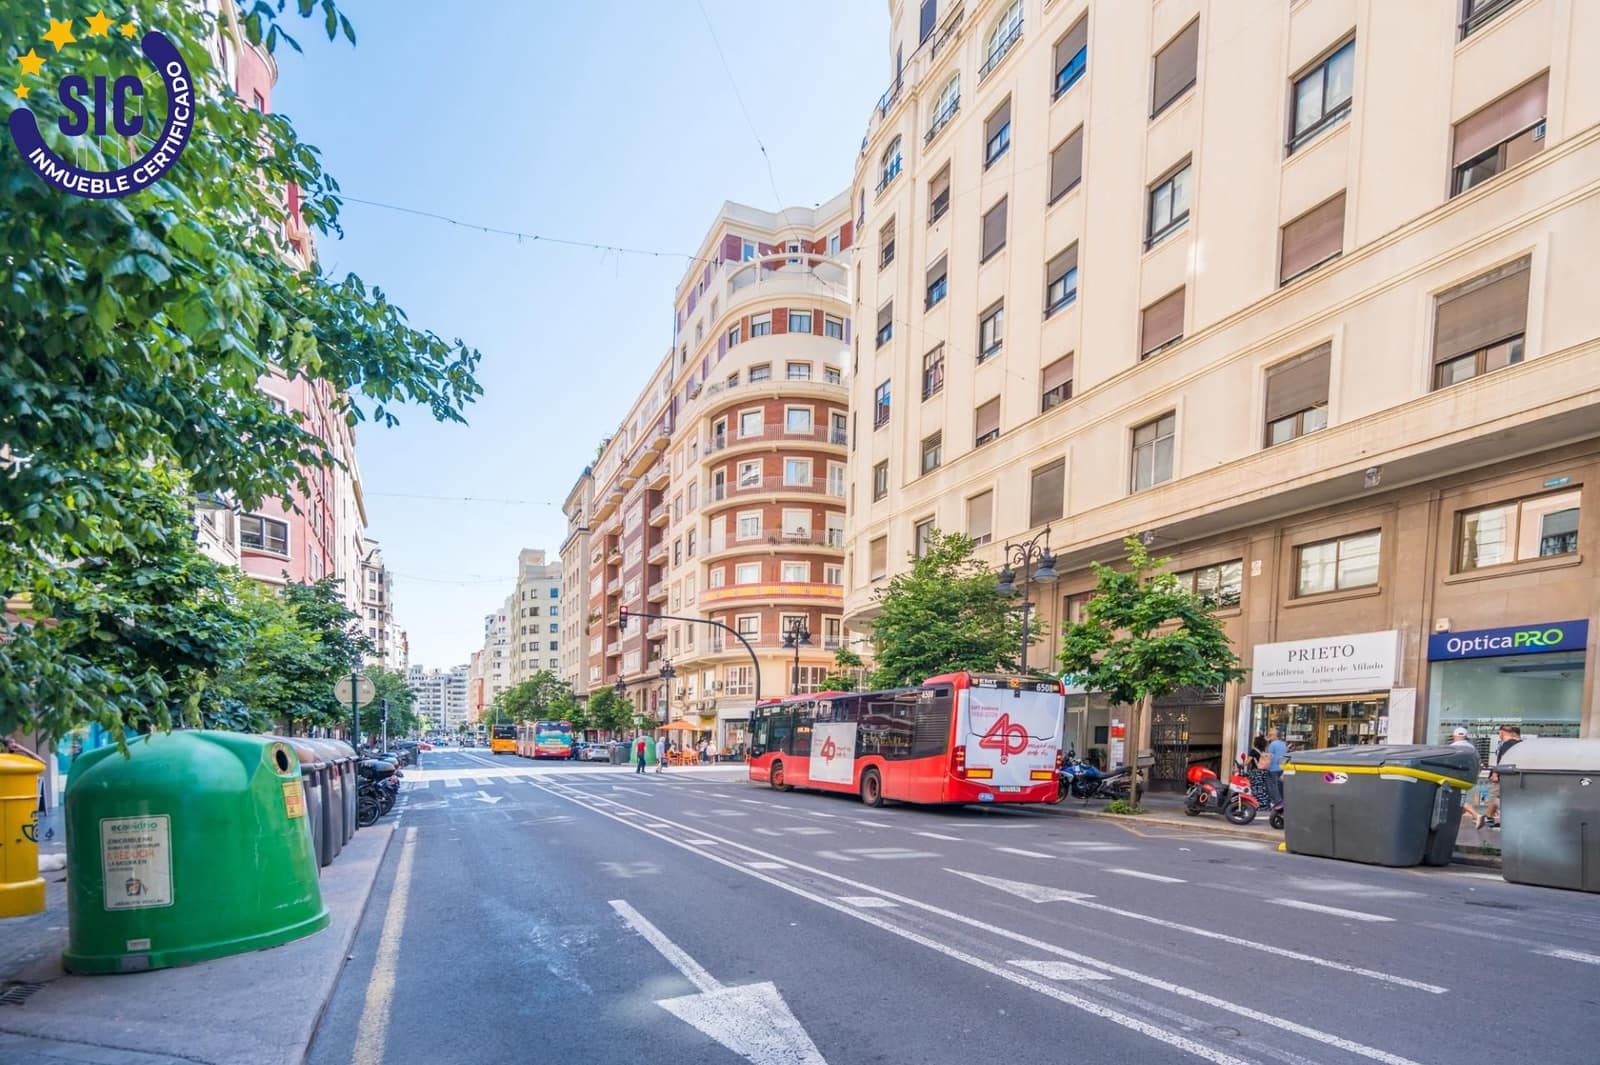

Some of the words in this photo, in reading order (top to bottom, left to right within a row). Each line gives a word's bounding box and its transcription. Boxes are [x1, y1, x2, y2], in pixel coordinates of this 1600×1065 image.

[1288, 644, 1355, 662] PRIETO
[1447, 628, 1564, 655] OpticaPRO
[820, 735, 836, 763] 40
[979, 713, 1029, 765] 40
